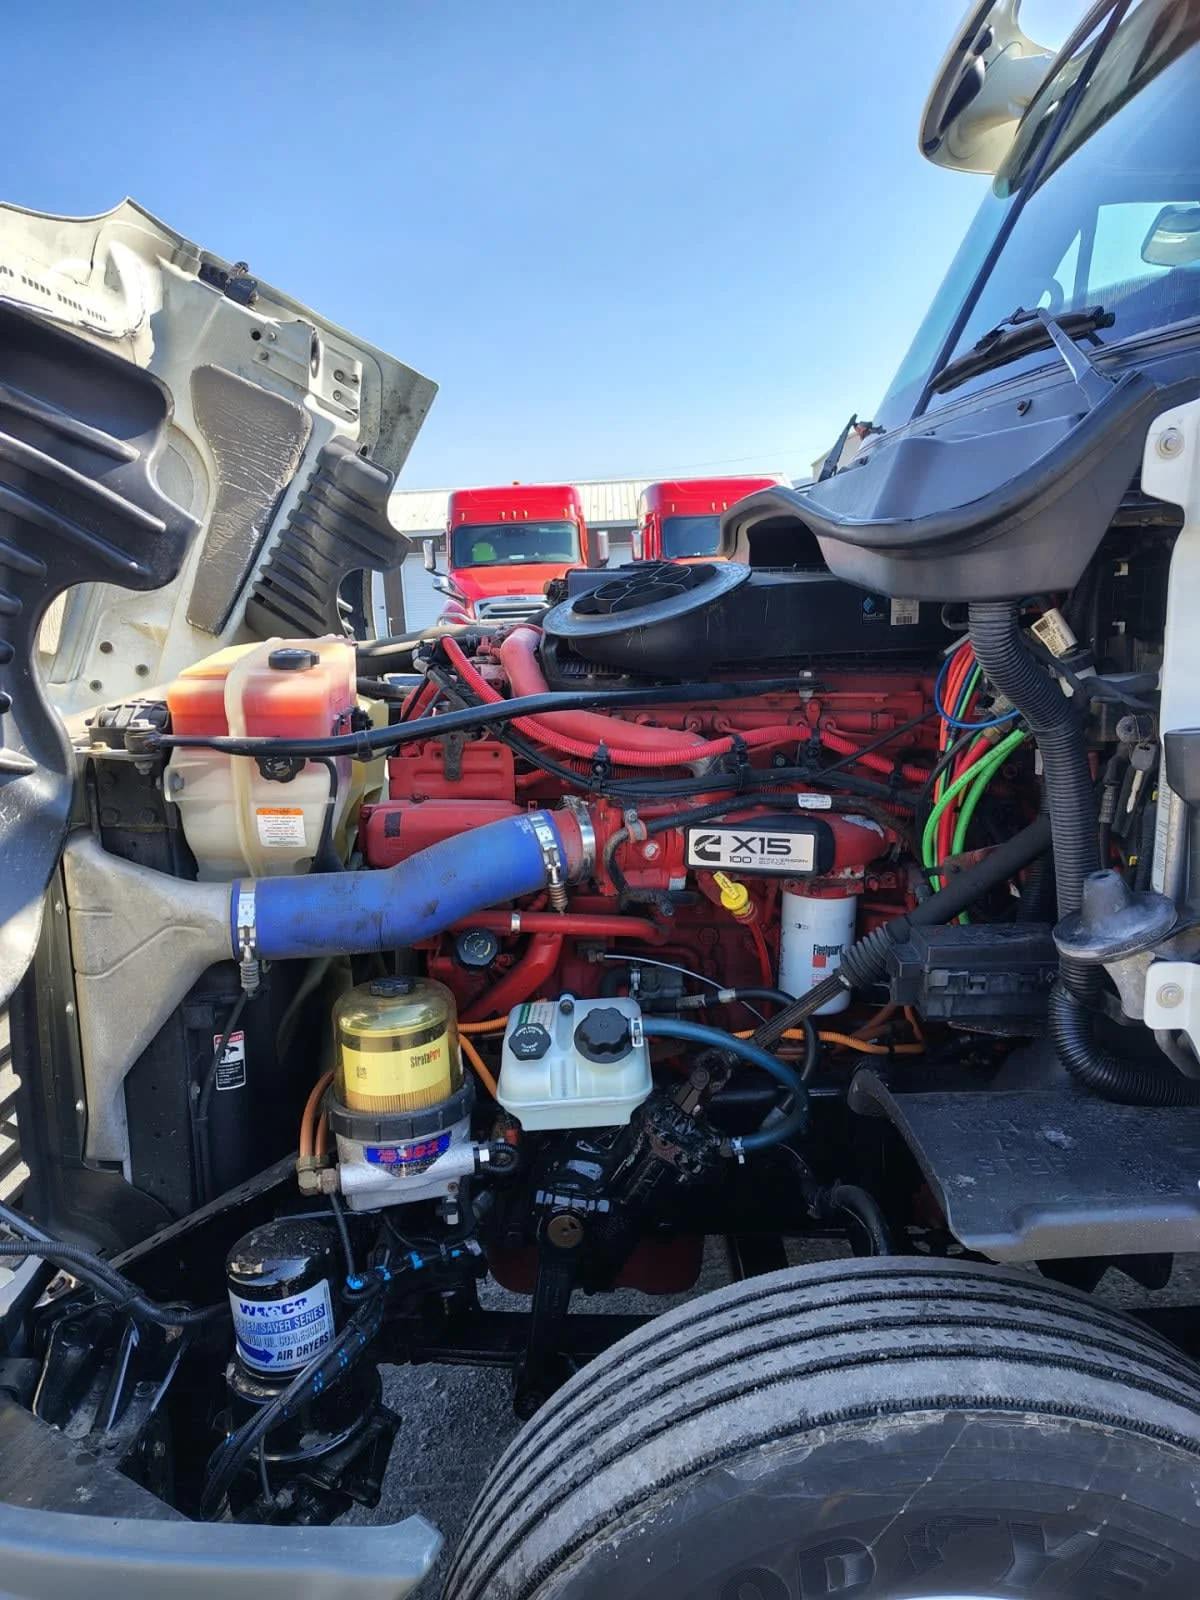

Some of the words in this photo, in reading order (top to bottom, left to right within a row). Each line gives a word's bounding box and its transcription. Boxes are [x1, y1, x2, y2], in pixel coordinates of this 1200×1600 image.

[731, 835, 792, 856] X15
[729, 855, 751, 863] 100
[261, 1318, 293, 1334] SAVER
[294, 1303, 326, 1329] SERIES
[276, 1349, 294, 1362] AIR
[296, 1331, 330, 1358] DRYERS
